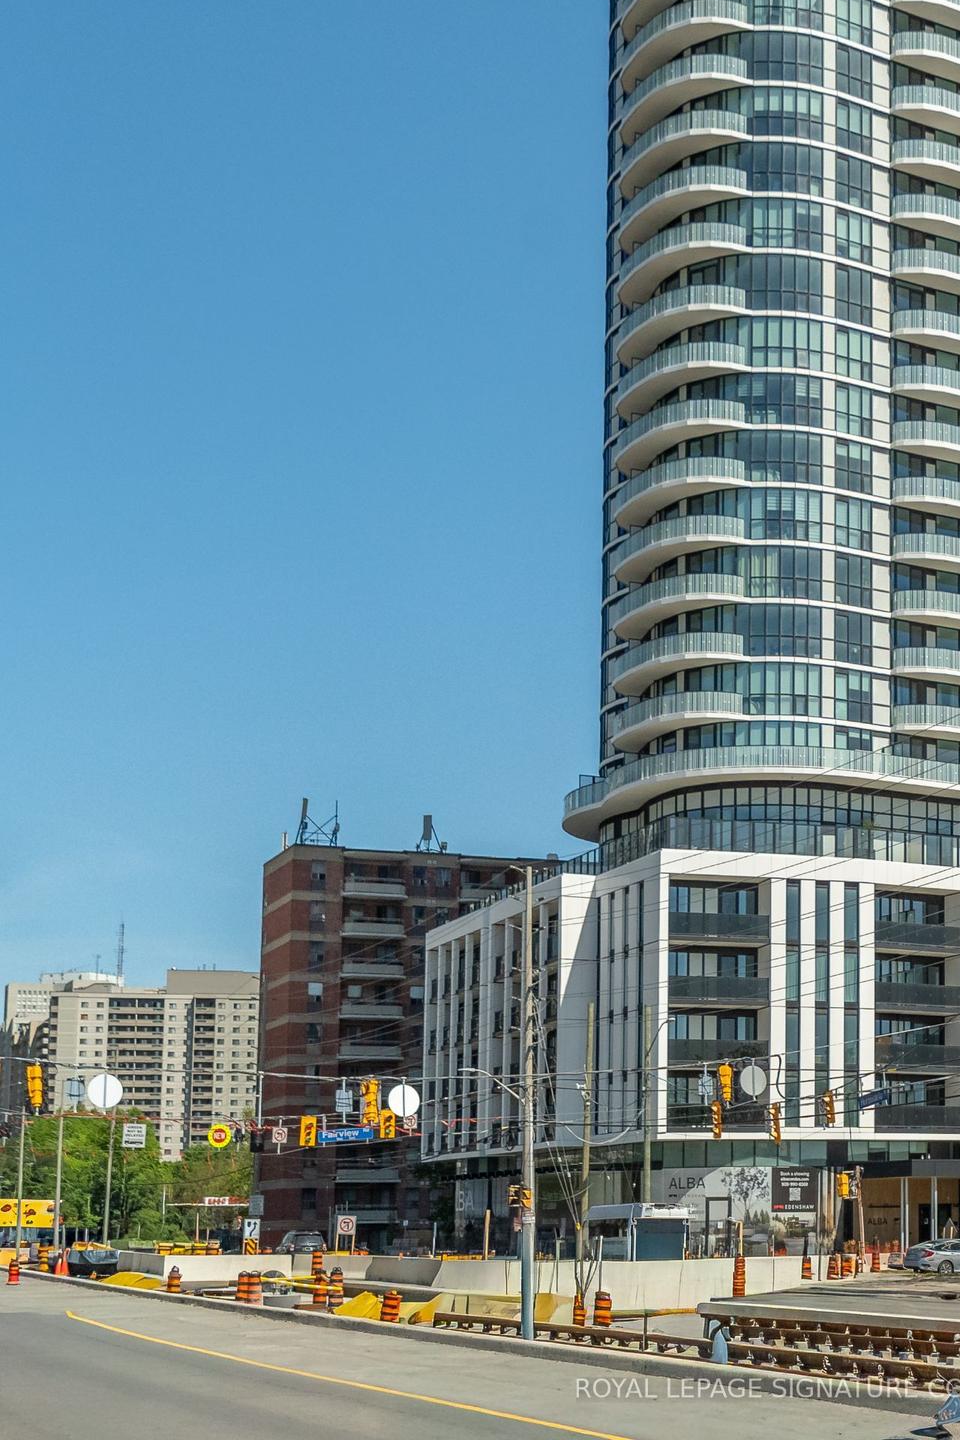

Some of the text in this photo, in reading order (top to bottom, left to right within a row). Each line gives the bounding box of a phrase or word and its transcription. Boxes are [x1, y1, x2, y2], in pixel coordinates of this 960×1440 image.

[322, 1129, 360, 1139] Fairview
[669, 1177, 706, 1190] ALBA
[867, 1217, 888, 1225] ALBA
